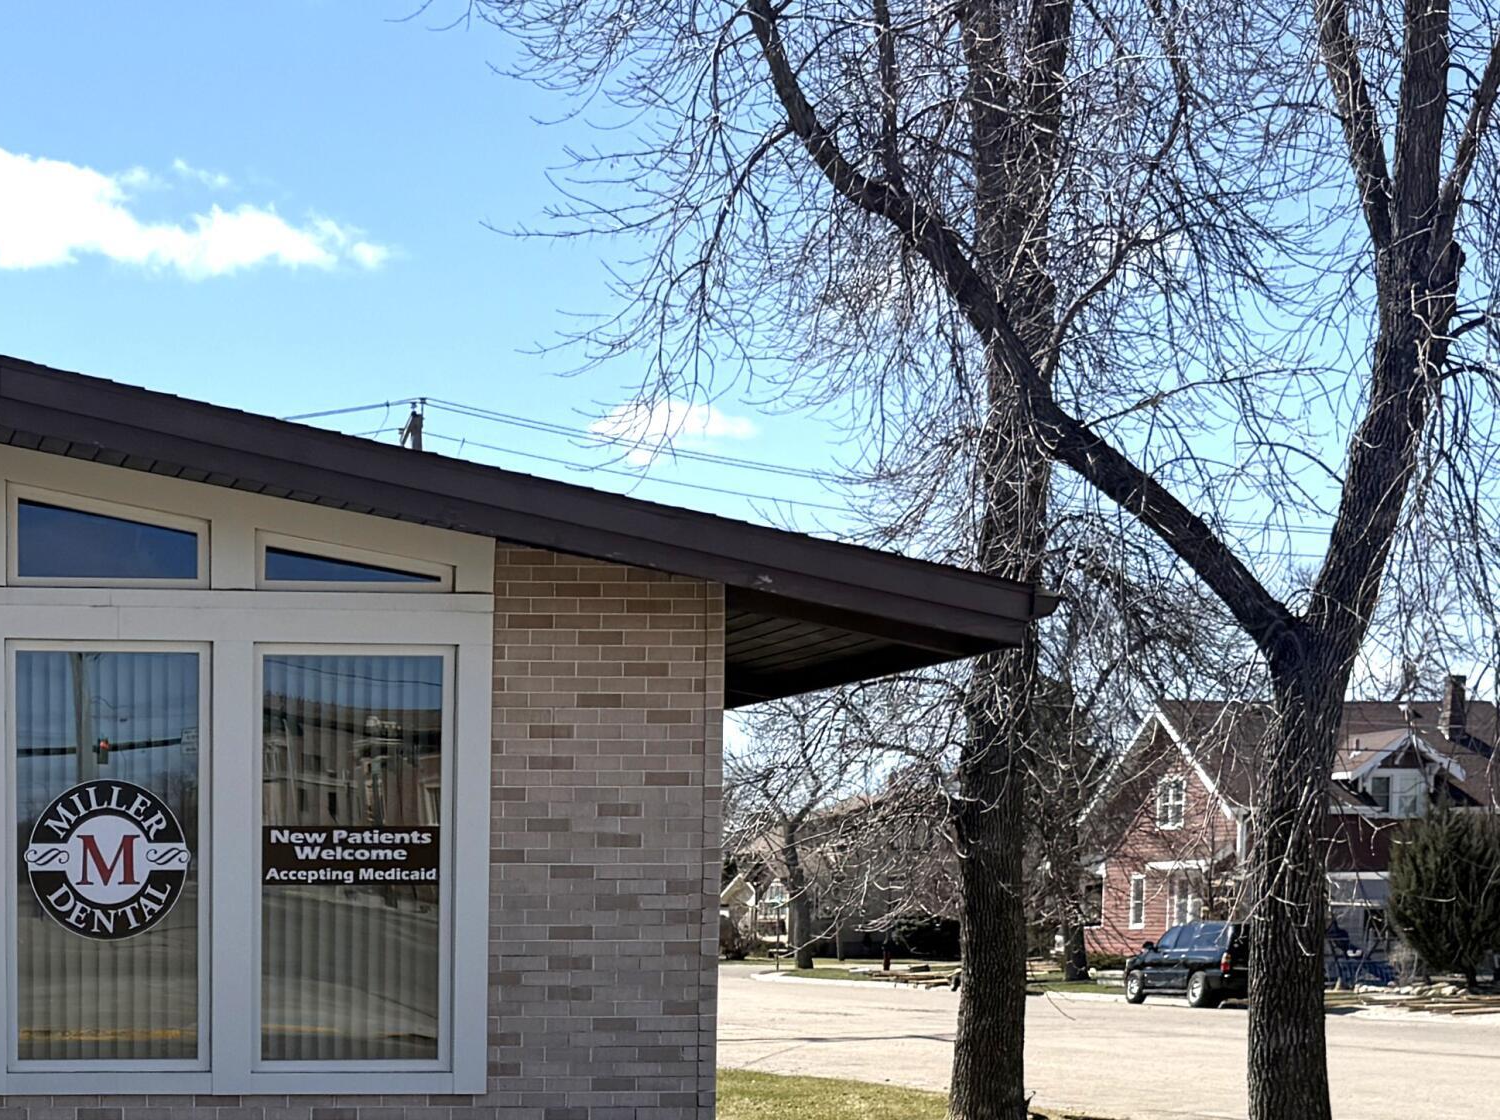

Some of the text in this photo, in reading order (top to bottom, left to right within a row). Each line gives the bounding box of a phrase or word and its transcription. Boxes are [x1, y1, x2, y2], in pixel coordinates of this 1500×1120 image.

[44, 786, 168, 840] MILLER
[270, 829, 432, 844] New Patients
[294, 846, 408, 860] Welcome
[75, 834, 141, 887] M
[266, 867, 437, 883] Accepting Medicaid
[46, 883, 172, 934] DENTAL
